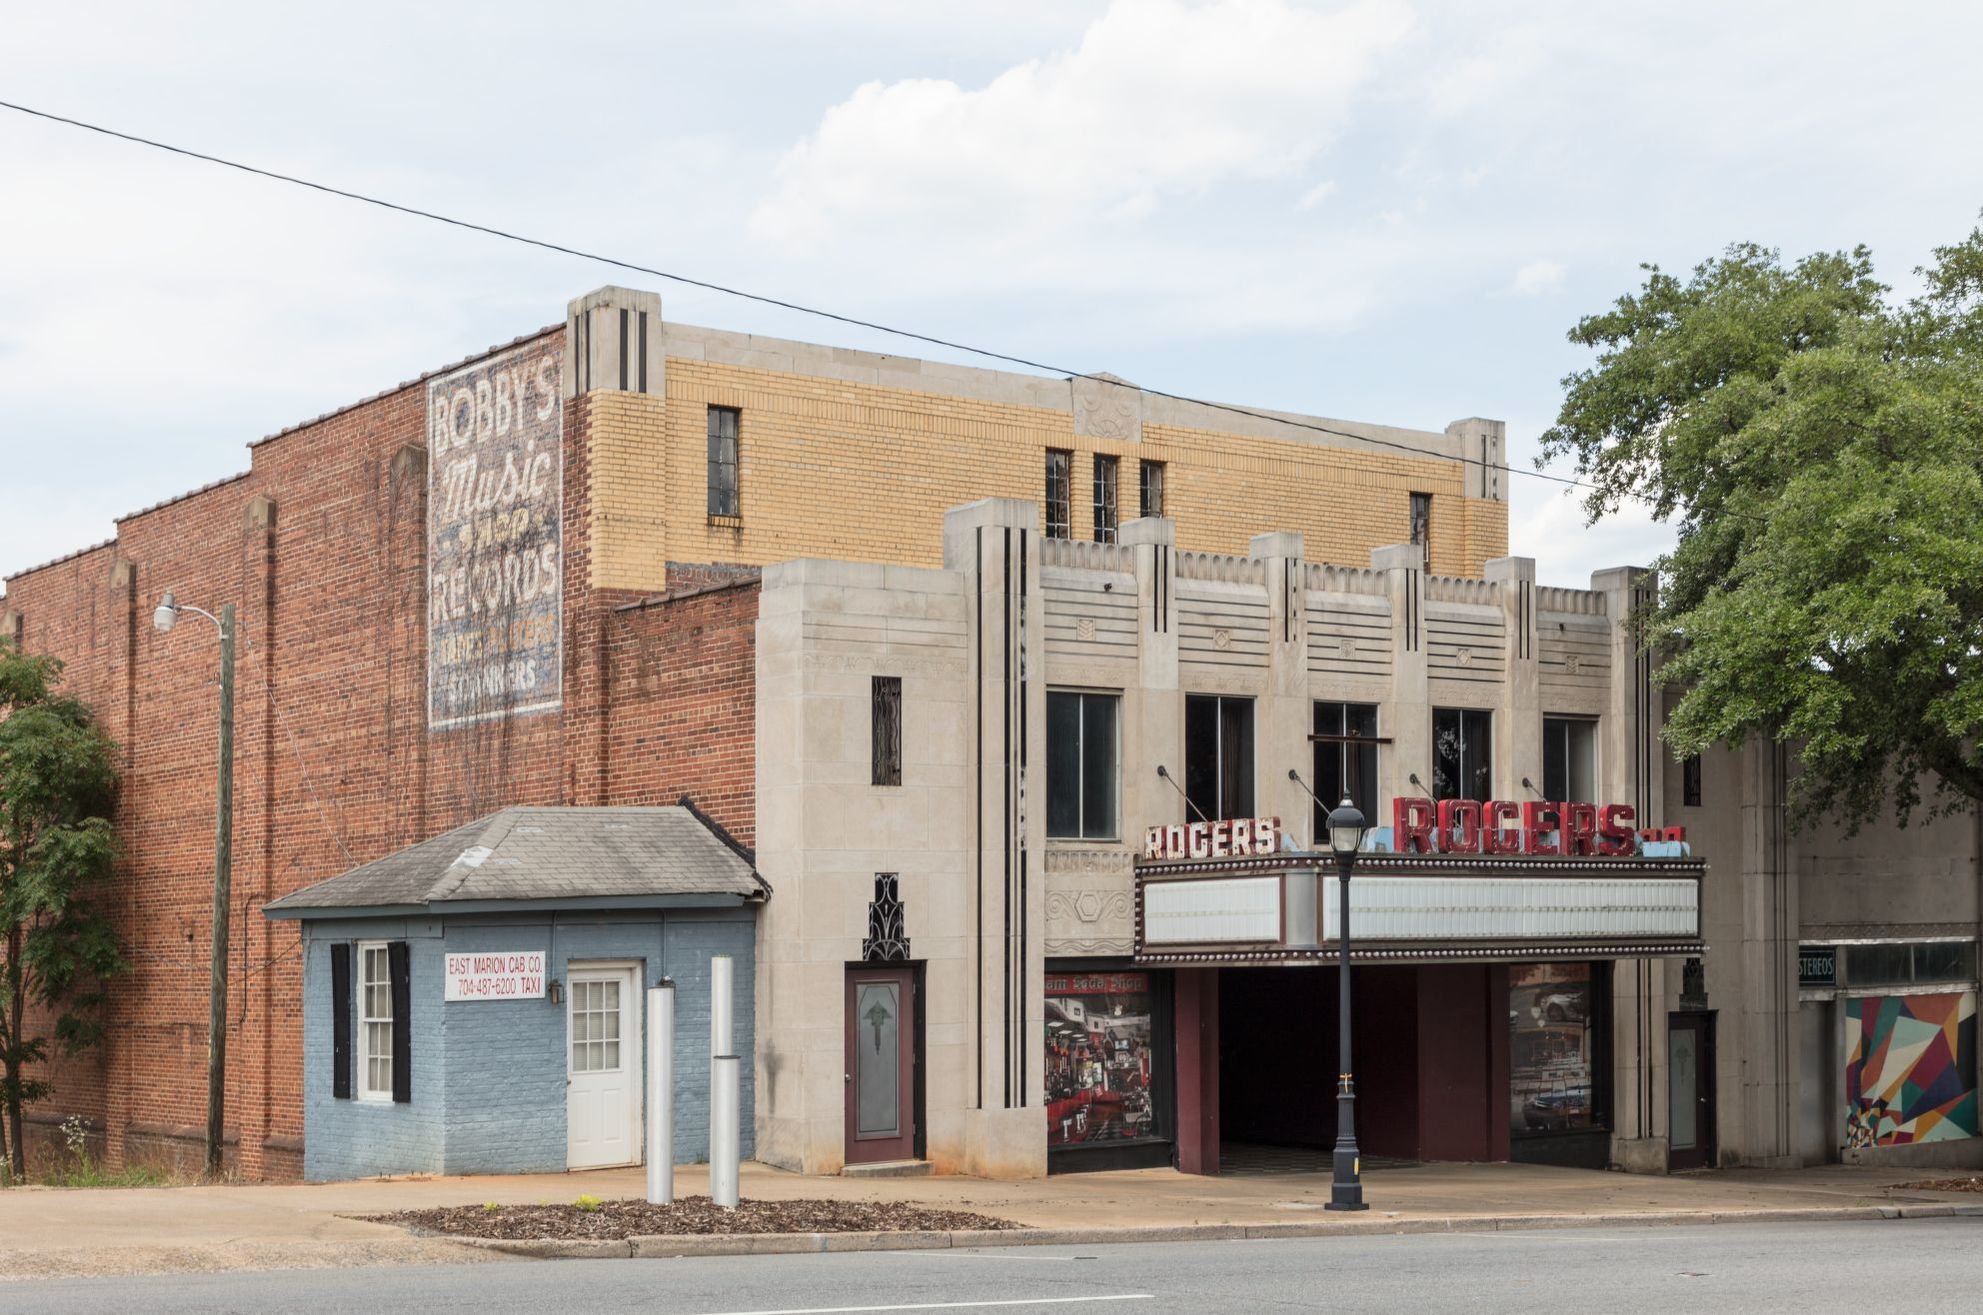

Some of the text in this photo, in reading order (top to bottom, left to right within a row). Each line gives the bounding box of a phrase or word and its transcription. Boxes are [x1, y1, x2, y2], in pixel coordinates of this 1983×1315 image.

[434, 356, 556, 458] BOBBY'S
[442, 439, 551, 520] Music
[432, 543, 557, 620] RECORDS
[1145, 816, 1280, 861] ROGERS
[1393, 797, 1635, 857] ROGERS
[449, 956, 542, 975] EAST MARION CAB CO.
[459, 976, 541, 996] 704-487-6200 TAXI
[1799, 957, 1834, 976] STEREOS
